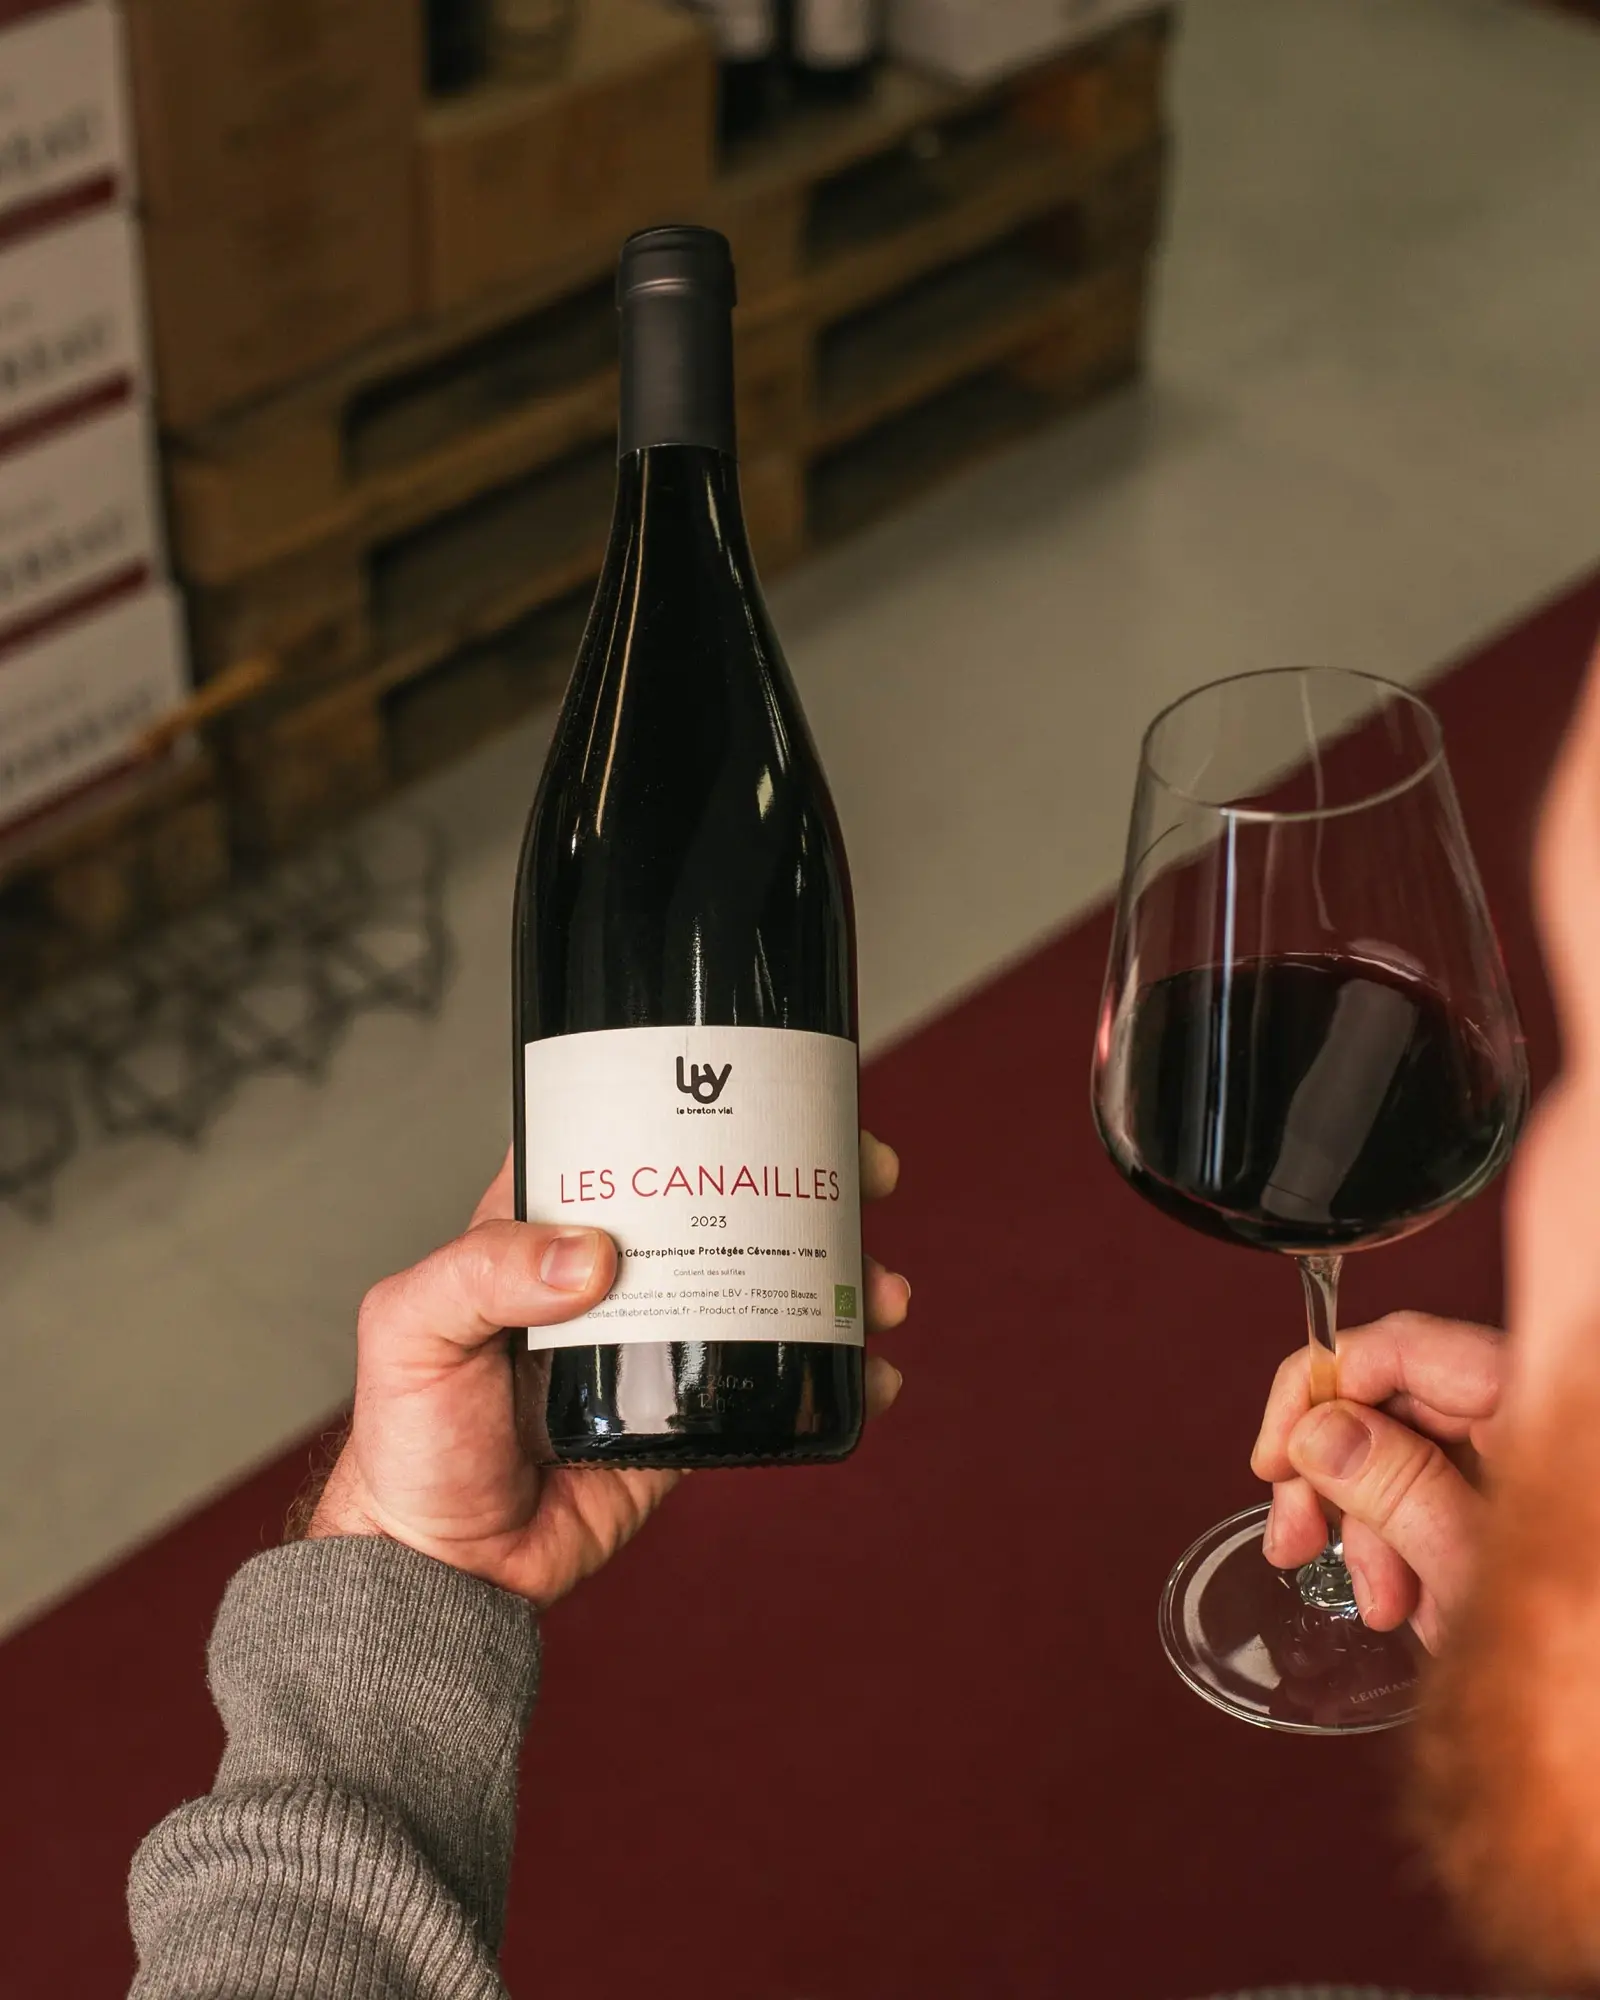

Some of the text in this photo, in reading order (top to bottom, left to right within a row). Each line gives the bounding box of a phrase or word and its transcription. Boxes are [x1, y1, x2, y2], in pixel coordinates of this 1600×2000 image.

[676, 1106, 733, 1115] le breton vial
[561, 1165, 840, 1203] LES CANAILLES
[690, 1215, 727, 1229] 2023
[625, 1247, 696, 1260] Géographique
[698, 1245, 745, 1258] Protégée
[746, 1245, 791, 1257] Cévennes
[797, 1247, 813, 1258] VIN
[814, 1247, 828, 1258] BIO
[720, 1268, 746, 1276] sulfites
[608, 1293, 620, 1301] en
[621, 1289, 664, 1300] bouteille
[666, 1290, 678, 1299] au
[679, 1288, 720, 1298] domaine
[722, 1288, 742, 1297] LBV
[751, 1288, 789, 1299] FR30700
[790, 1288, 818, 1300] Blauzac
[587, 1306, 691, 1319] contact@lebretonvial.fr
[699, 1306, 736, 1315] Product
[738, 1306, 748, 1315] of
[751, 1306, 779, 1315] France
